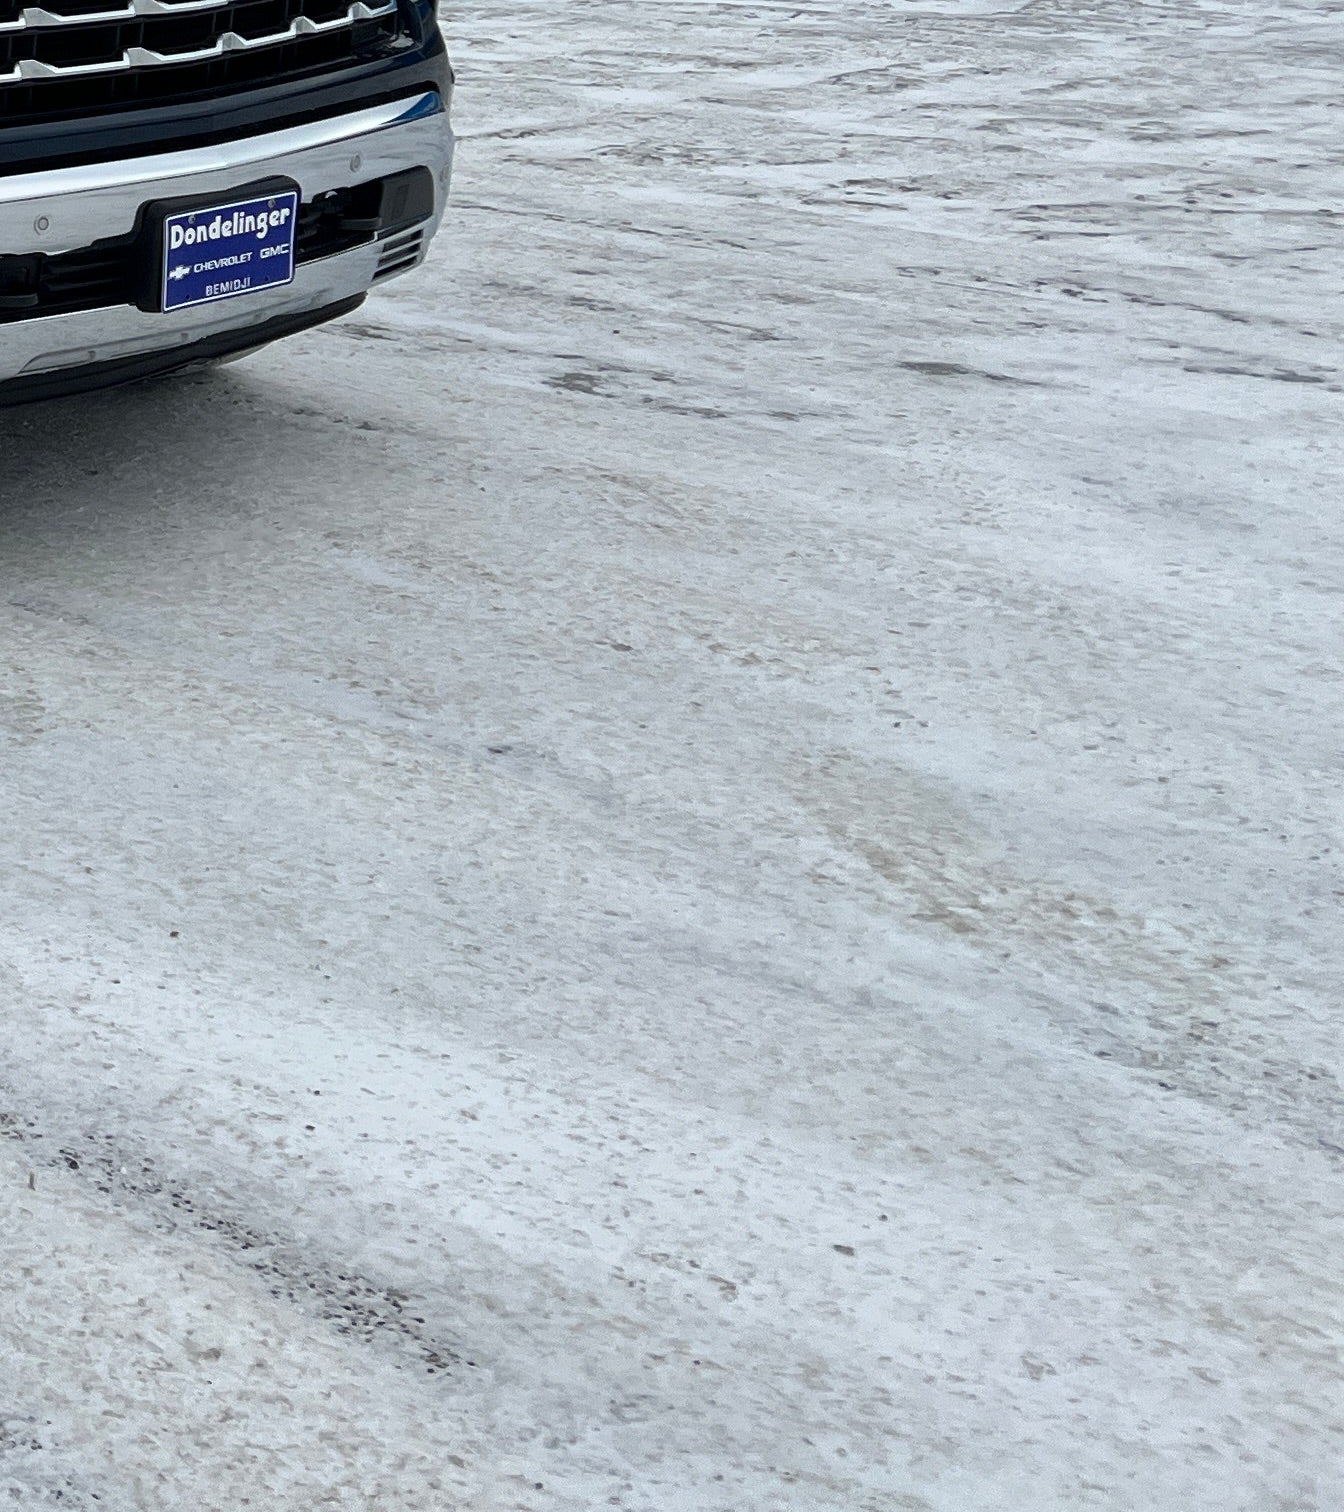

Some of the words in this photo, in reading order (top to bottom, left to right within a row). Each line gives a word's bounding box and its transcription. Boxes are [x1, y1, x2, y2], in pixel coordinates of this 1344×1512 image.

[170, 207, 291, 250] Dondelinger
[193, 251, 253, 273] CHEVROLET
[259, 243, 290, 259] GMC
[205, 276, 251, 297] BEMIDJI
